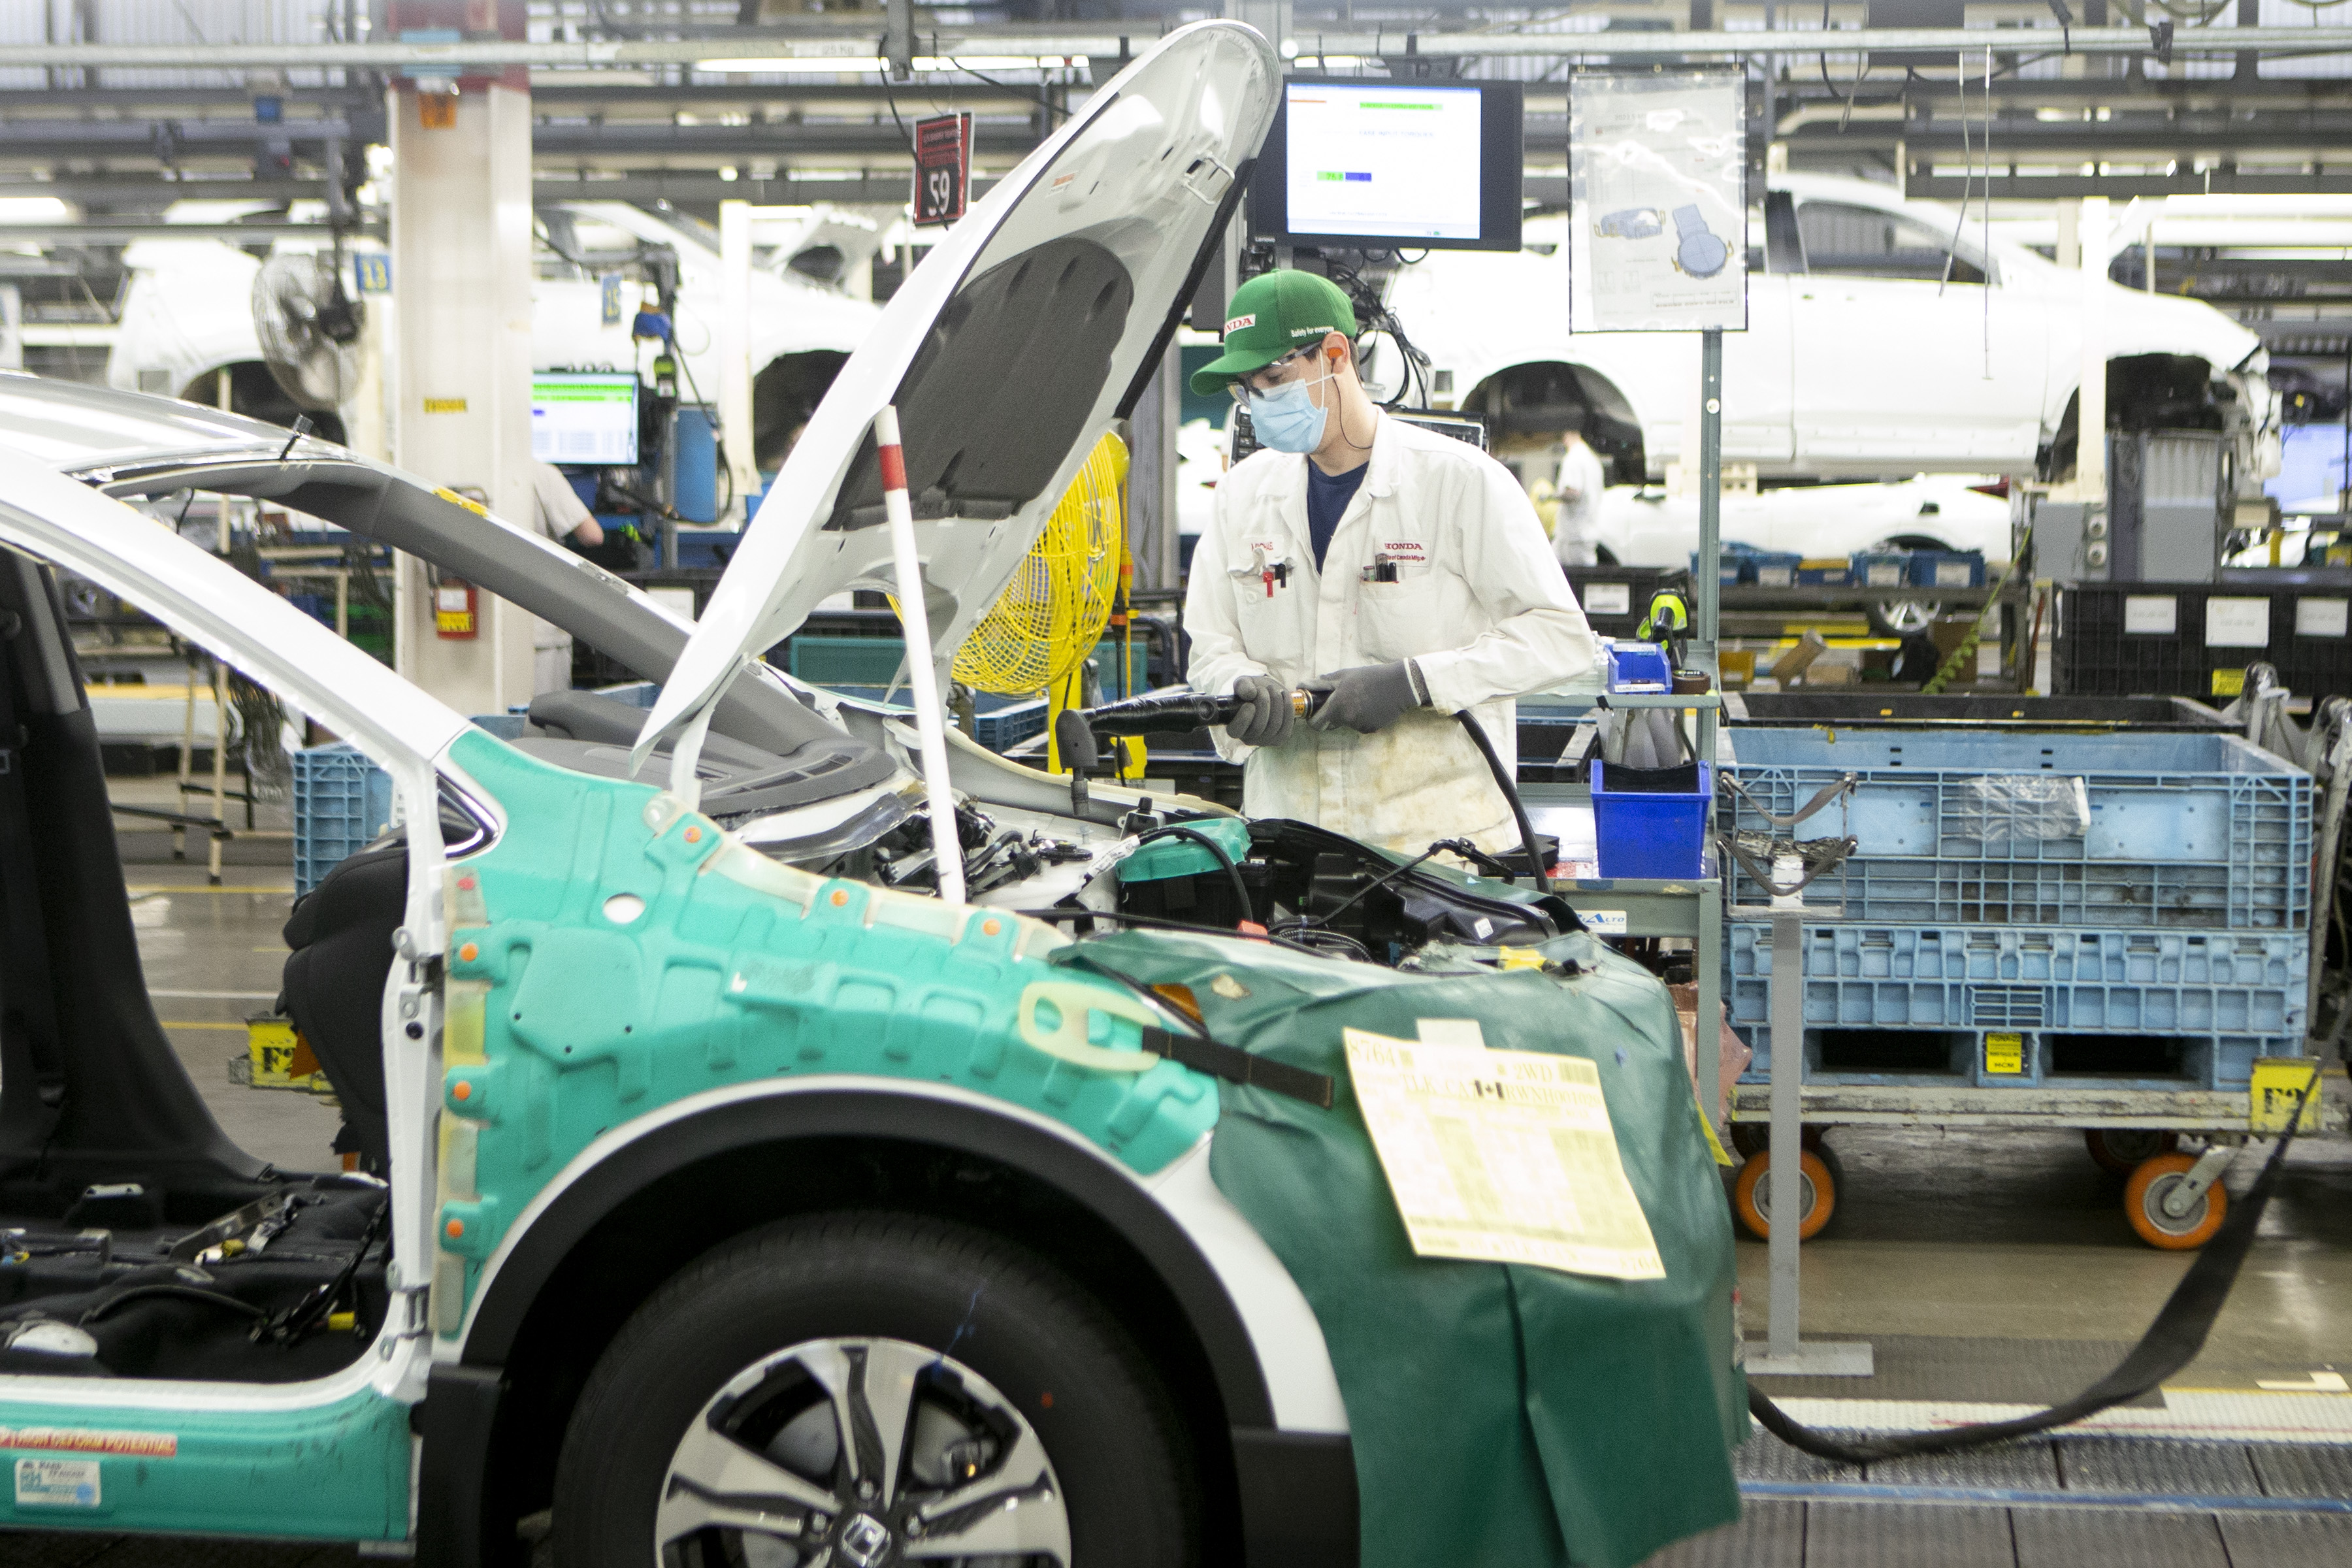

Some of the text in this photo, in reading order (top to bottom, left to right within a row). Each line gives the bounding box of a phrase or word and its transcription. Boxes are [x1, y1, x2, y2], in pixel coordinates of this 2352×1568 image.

[928, 171, 950, 217] 59
[1291, 329, 1306, 337] Safety
[1348, 1038, 1552, 1083] 8764 2WD
[1399, 1073, 1437, 1094] TLK
